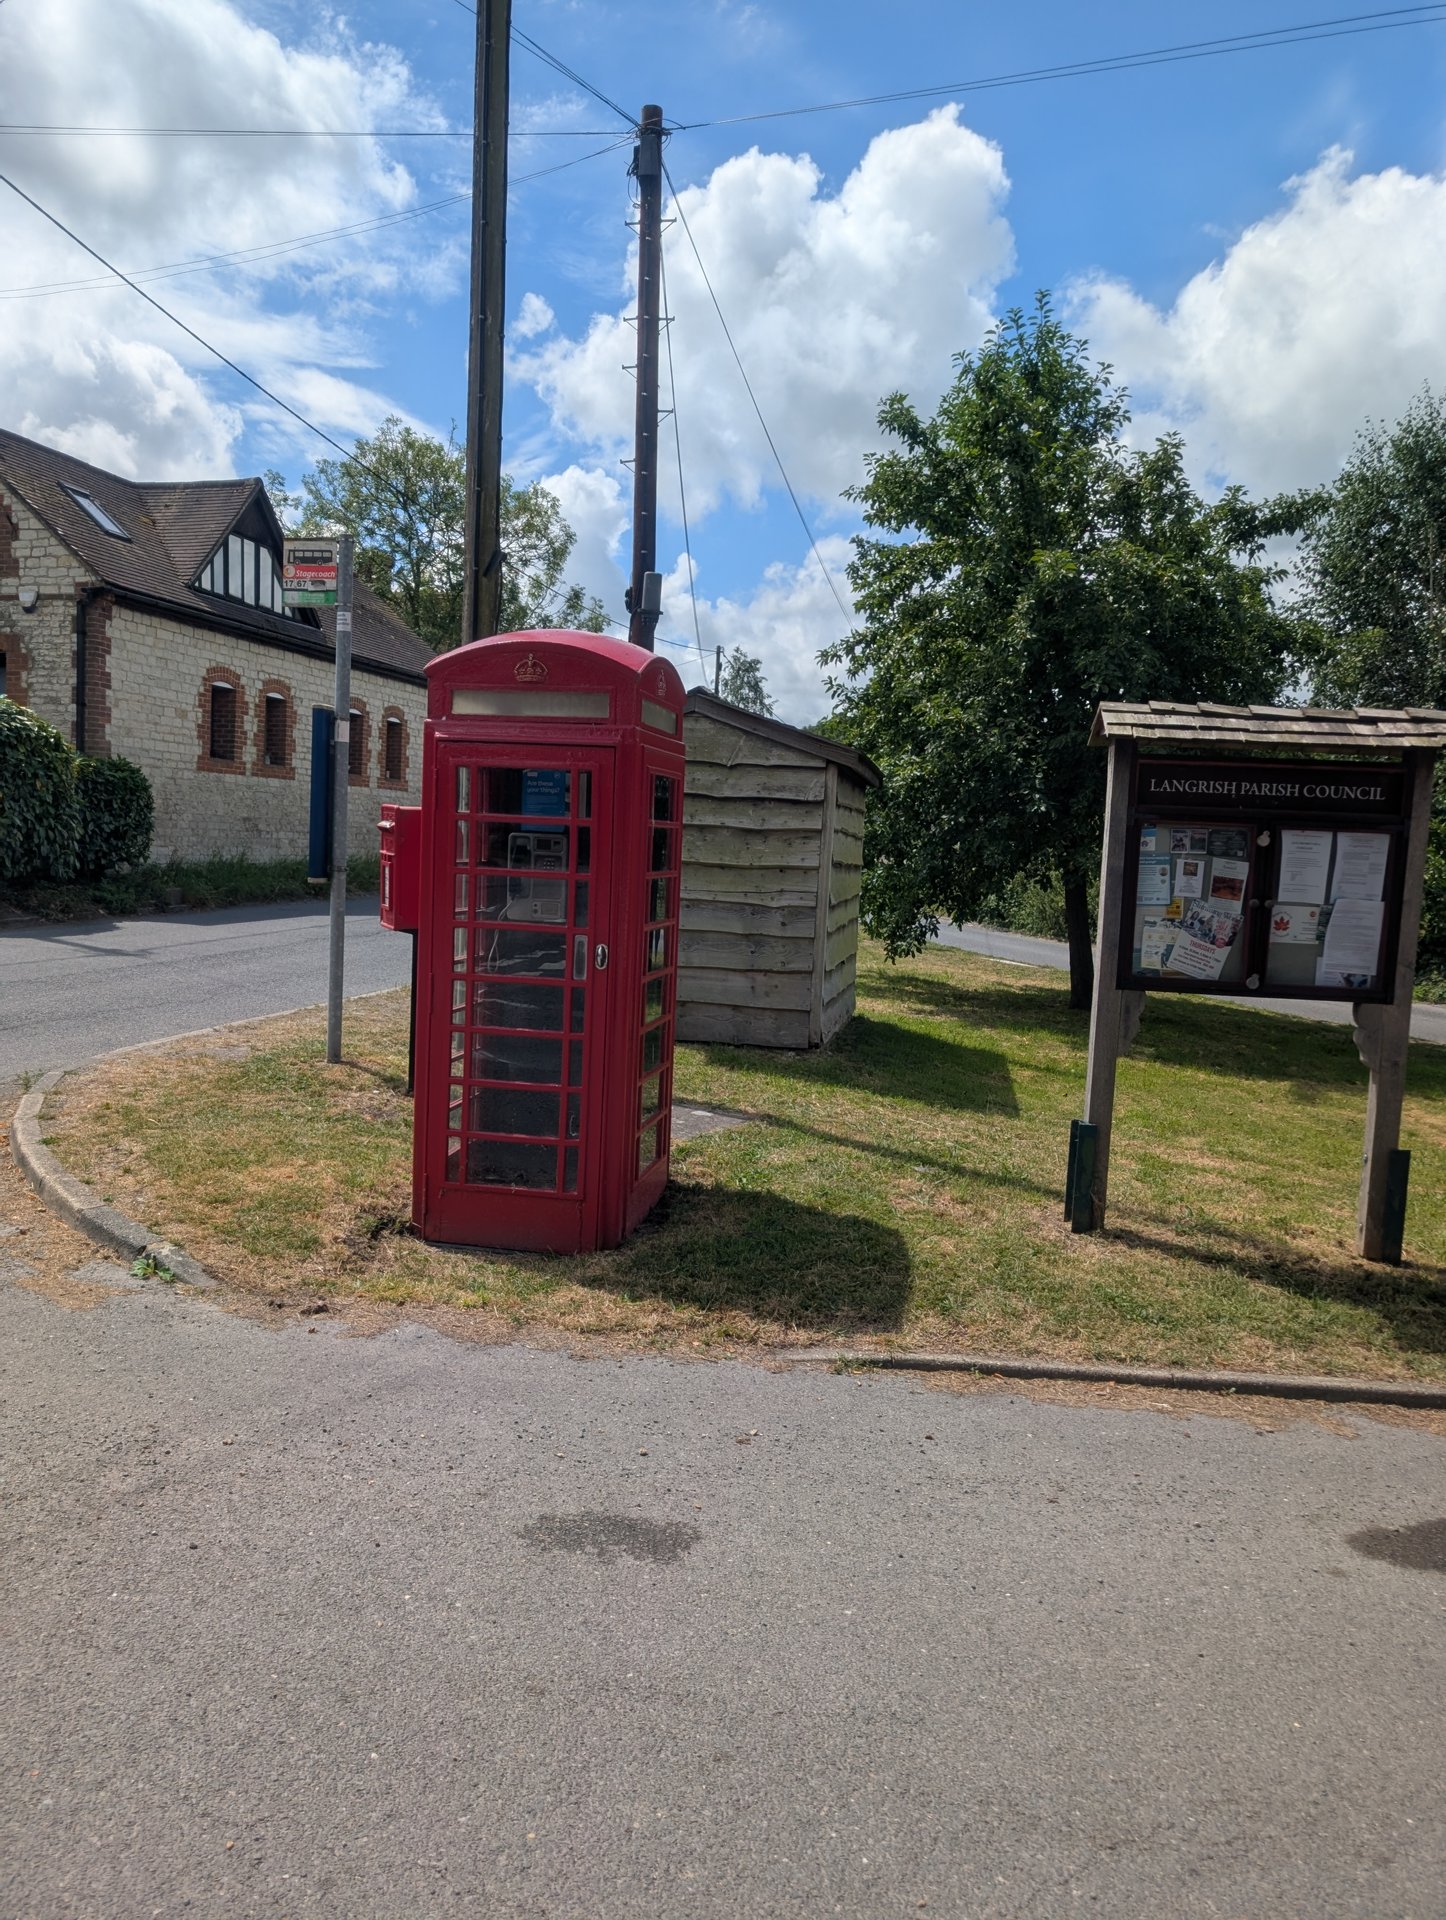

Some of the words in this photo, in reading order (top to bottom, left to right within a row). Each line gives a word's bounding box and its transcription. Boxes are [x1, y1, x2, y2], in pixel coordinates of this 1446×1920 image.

[296, 570, 335, 578] Stagecoach
[1150, 778, 1237, 794] LANGRISH
[1240, 782, 1300, 797] PARISH
[1303, 784, 1386, 801] COUNCIL
